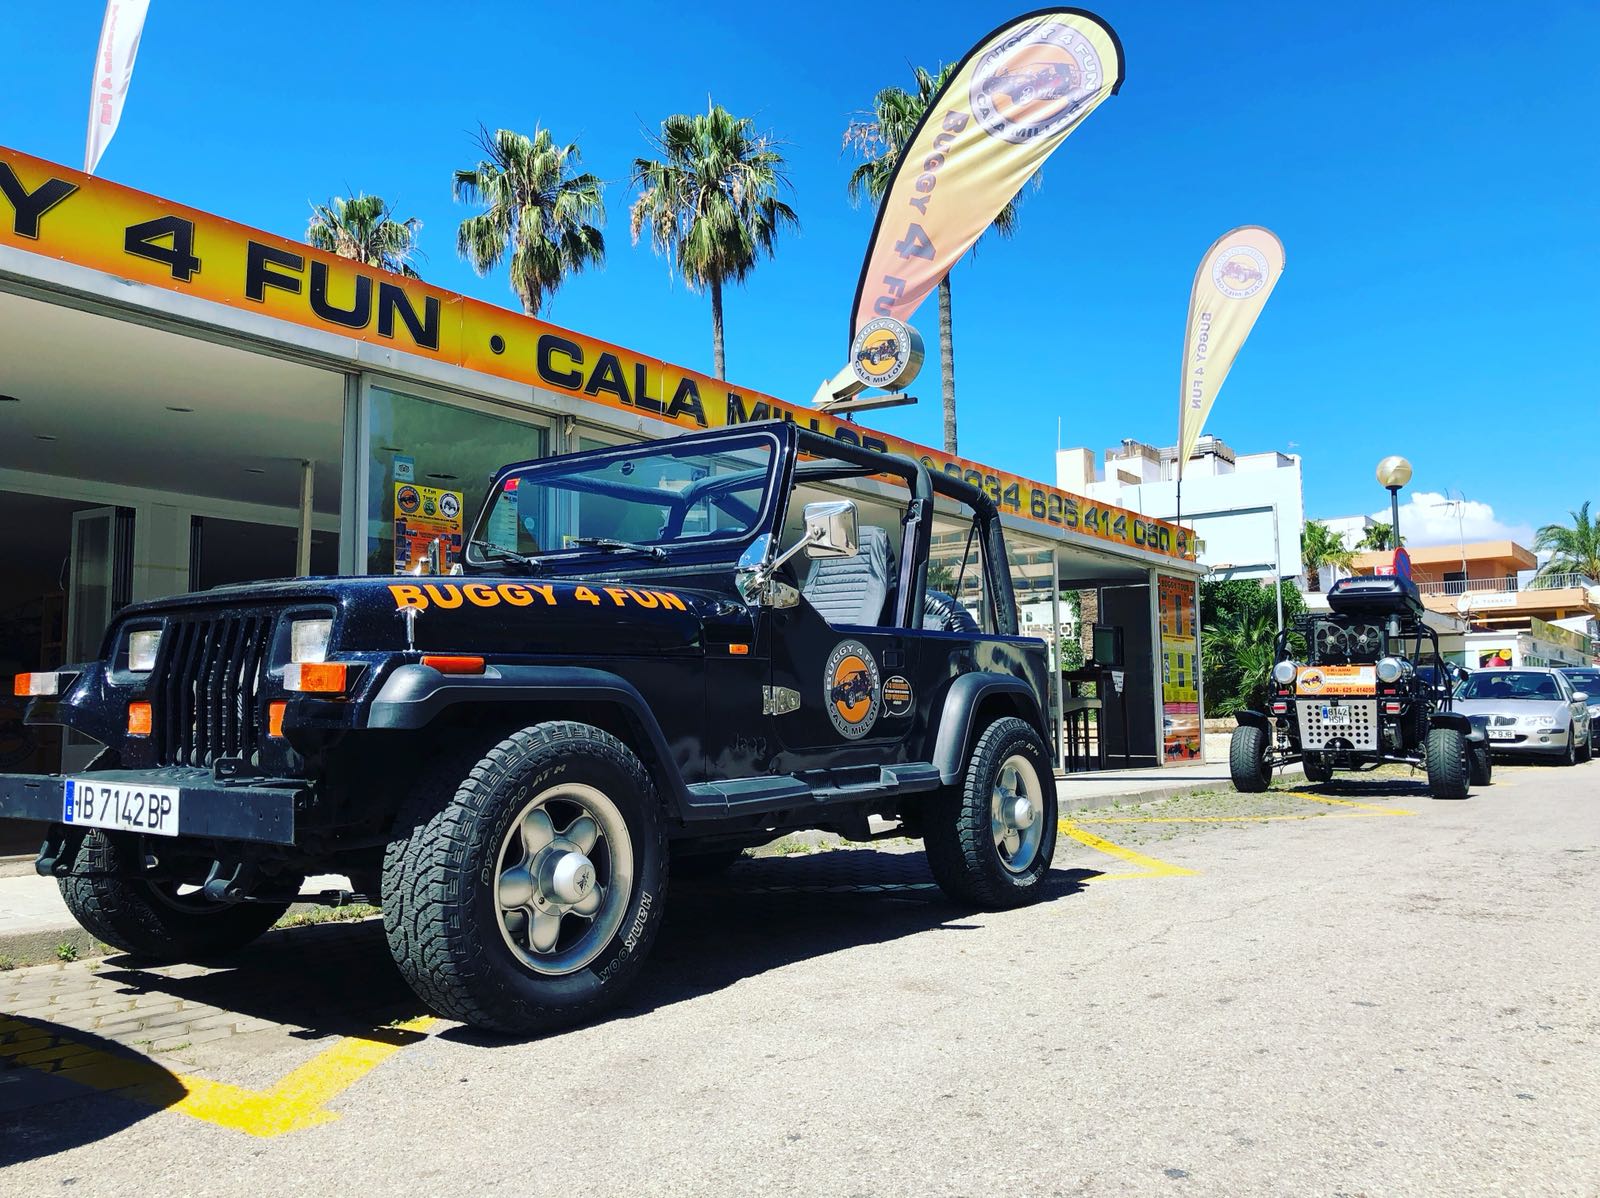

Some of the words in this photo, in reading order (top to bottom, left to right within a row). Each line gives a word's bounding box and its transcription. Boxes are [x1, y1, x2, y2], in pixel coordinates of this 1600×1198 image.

[909, 110, 970, 216] BUGGY
[894, 222, 937, 263] 4
[873, 275, 907, 319] FU
[124, 215, 200, 282] 4
[245, 240, 440, 350] FUN
[537, 335, 708, 427] CALA
[855, 321, 886, 352] BUGGY
[896, 327, 907, 352] FUN
[855, 360, 871, 381] CALA
[872, 360, 904, 383] MILLOR
[1031, 488, 1078, 528] 625
[1084, 506, 1127, 540] 414
[388, 584, 557, 610] BUGGY
[574, 585, 601, 606] 4
[602, 587, 687, 611] FUN
[826, 645, 854, 690] BUGGY
[864, 654, 879, 689] FUN
[829, 703, 849, 734] CALA
[851, 701, 878, 735] MILLOR
[1328, 708, 1347, 716] 8142
